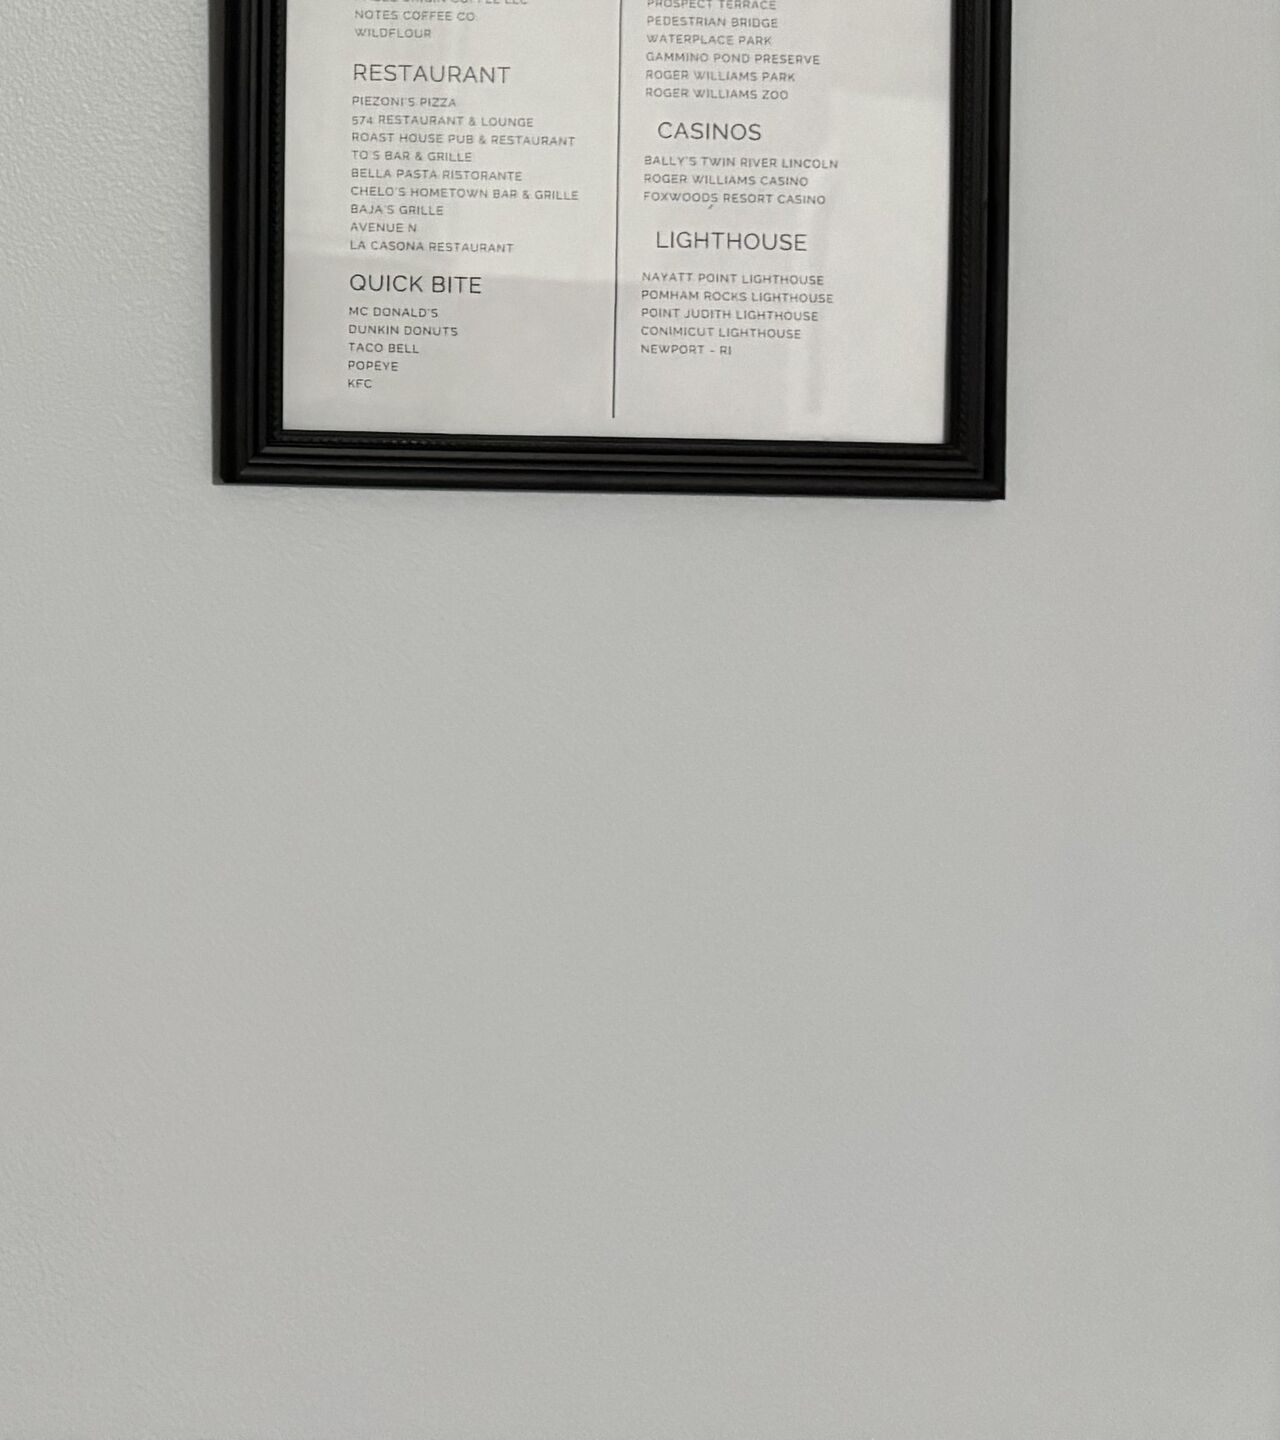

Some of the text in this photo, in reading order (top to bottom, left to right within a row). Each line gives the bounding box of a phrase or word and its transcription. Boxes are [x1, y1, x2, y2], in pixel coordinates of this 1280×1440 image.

[353, 63, 511, 84] RESTAURANT
[657, 121, 762, 141] CASINOS
[700, 156, 736, 167] TWIN
[740, 157, 777, 168] RIVER
[781, 158, 839, 169] LINCOLN
[351, 167, 522, 181] BELLA PASTA RISTORANTE
[643, 173, 808, 187] ROGER WILLIAMS CASINO
[643, 191, 826, 205] FOXWOODS RESORT CASINO
[398, 205, 444, 216] GRILLE
[349, 239, 514, 253] LA CASONA RESTAURANT
[656, 230, 808, 251] LIGHTHOUSE
[349, 273, 482, 294] QUICK BITE
[642, 271, 824, 286] NAYATT POINT LIGHTHOUSE
[641, 289, 834, 304] POMHAM ROCKS LIGHTHOUSE
[348, 306, 368, 316] MC
[641, 307, 819, 322] POINT JUDITH LIGHTHOUSE
[348, 323, 458, 337] DUNKIN DONUTS
[640, 325, 801, 339] CONIMICUT LIGHTHOUSE
[348, 341, 420, 354] TACO BELL
[348, 360, 399, 372] POPEYE
[347, 378, 373, 389] KFC
